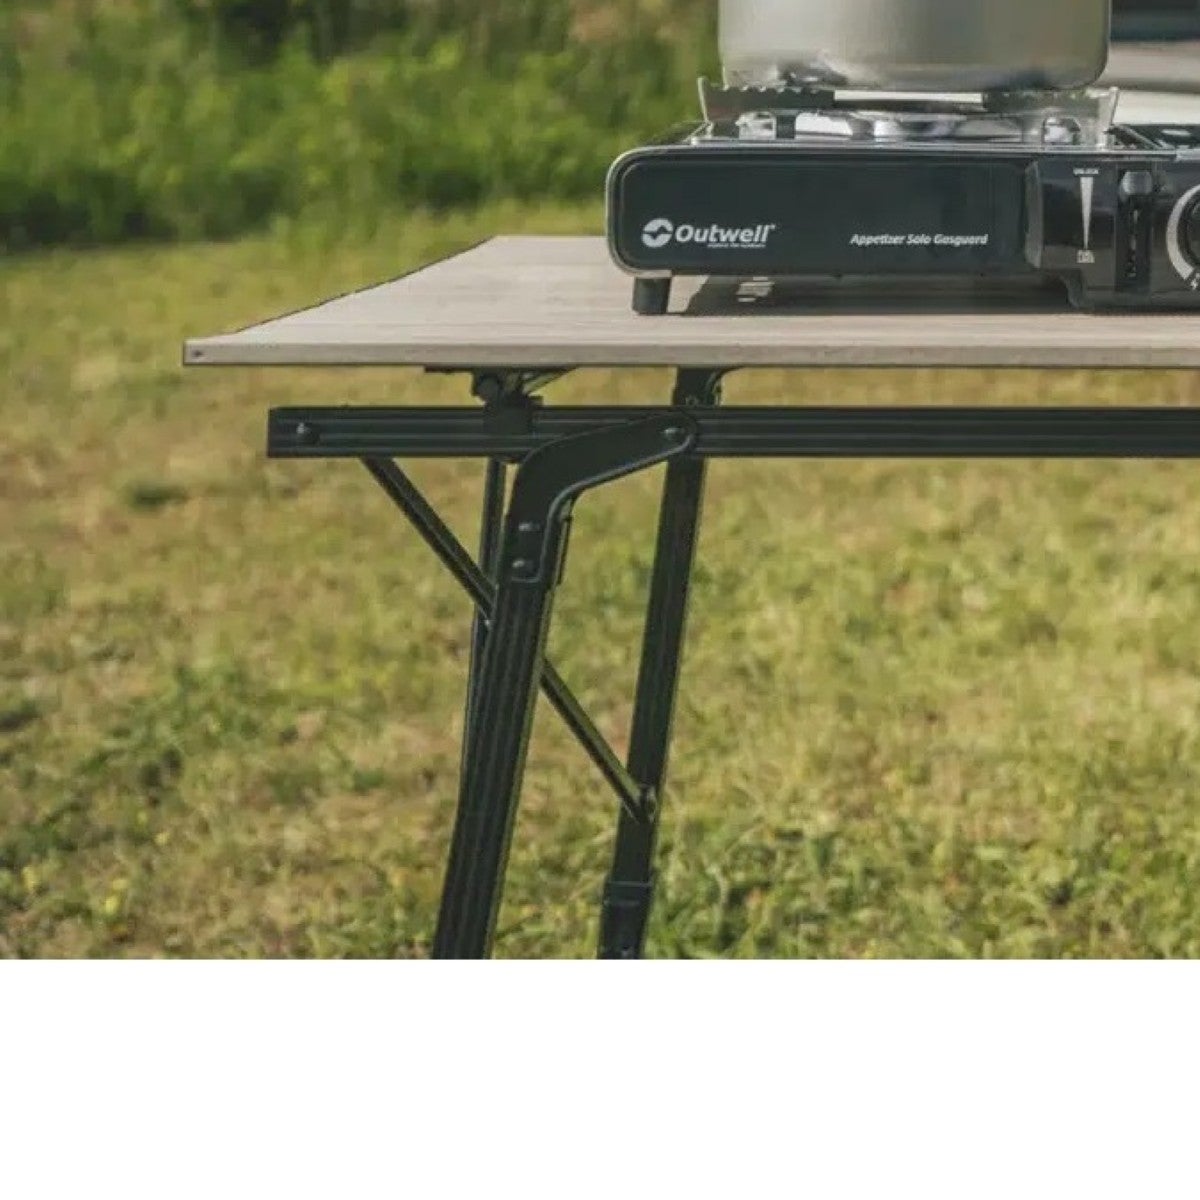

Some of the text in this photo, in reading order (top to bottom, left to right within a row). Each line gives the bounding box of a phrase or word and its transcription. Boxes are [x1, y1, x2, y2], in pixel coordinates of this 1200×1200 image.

[675, 224, 772, 243] Outwell
[850, 234, 989, 247] Appetizer Solo Gasguard
